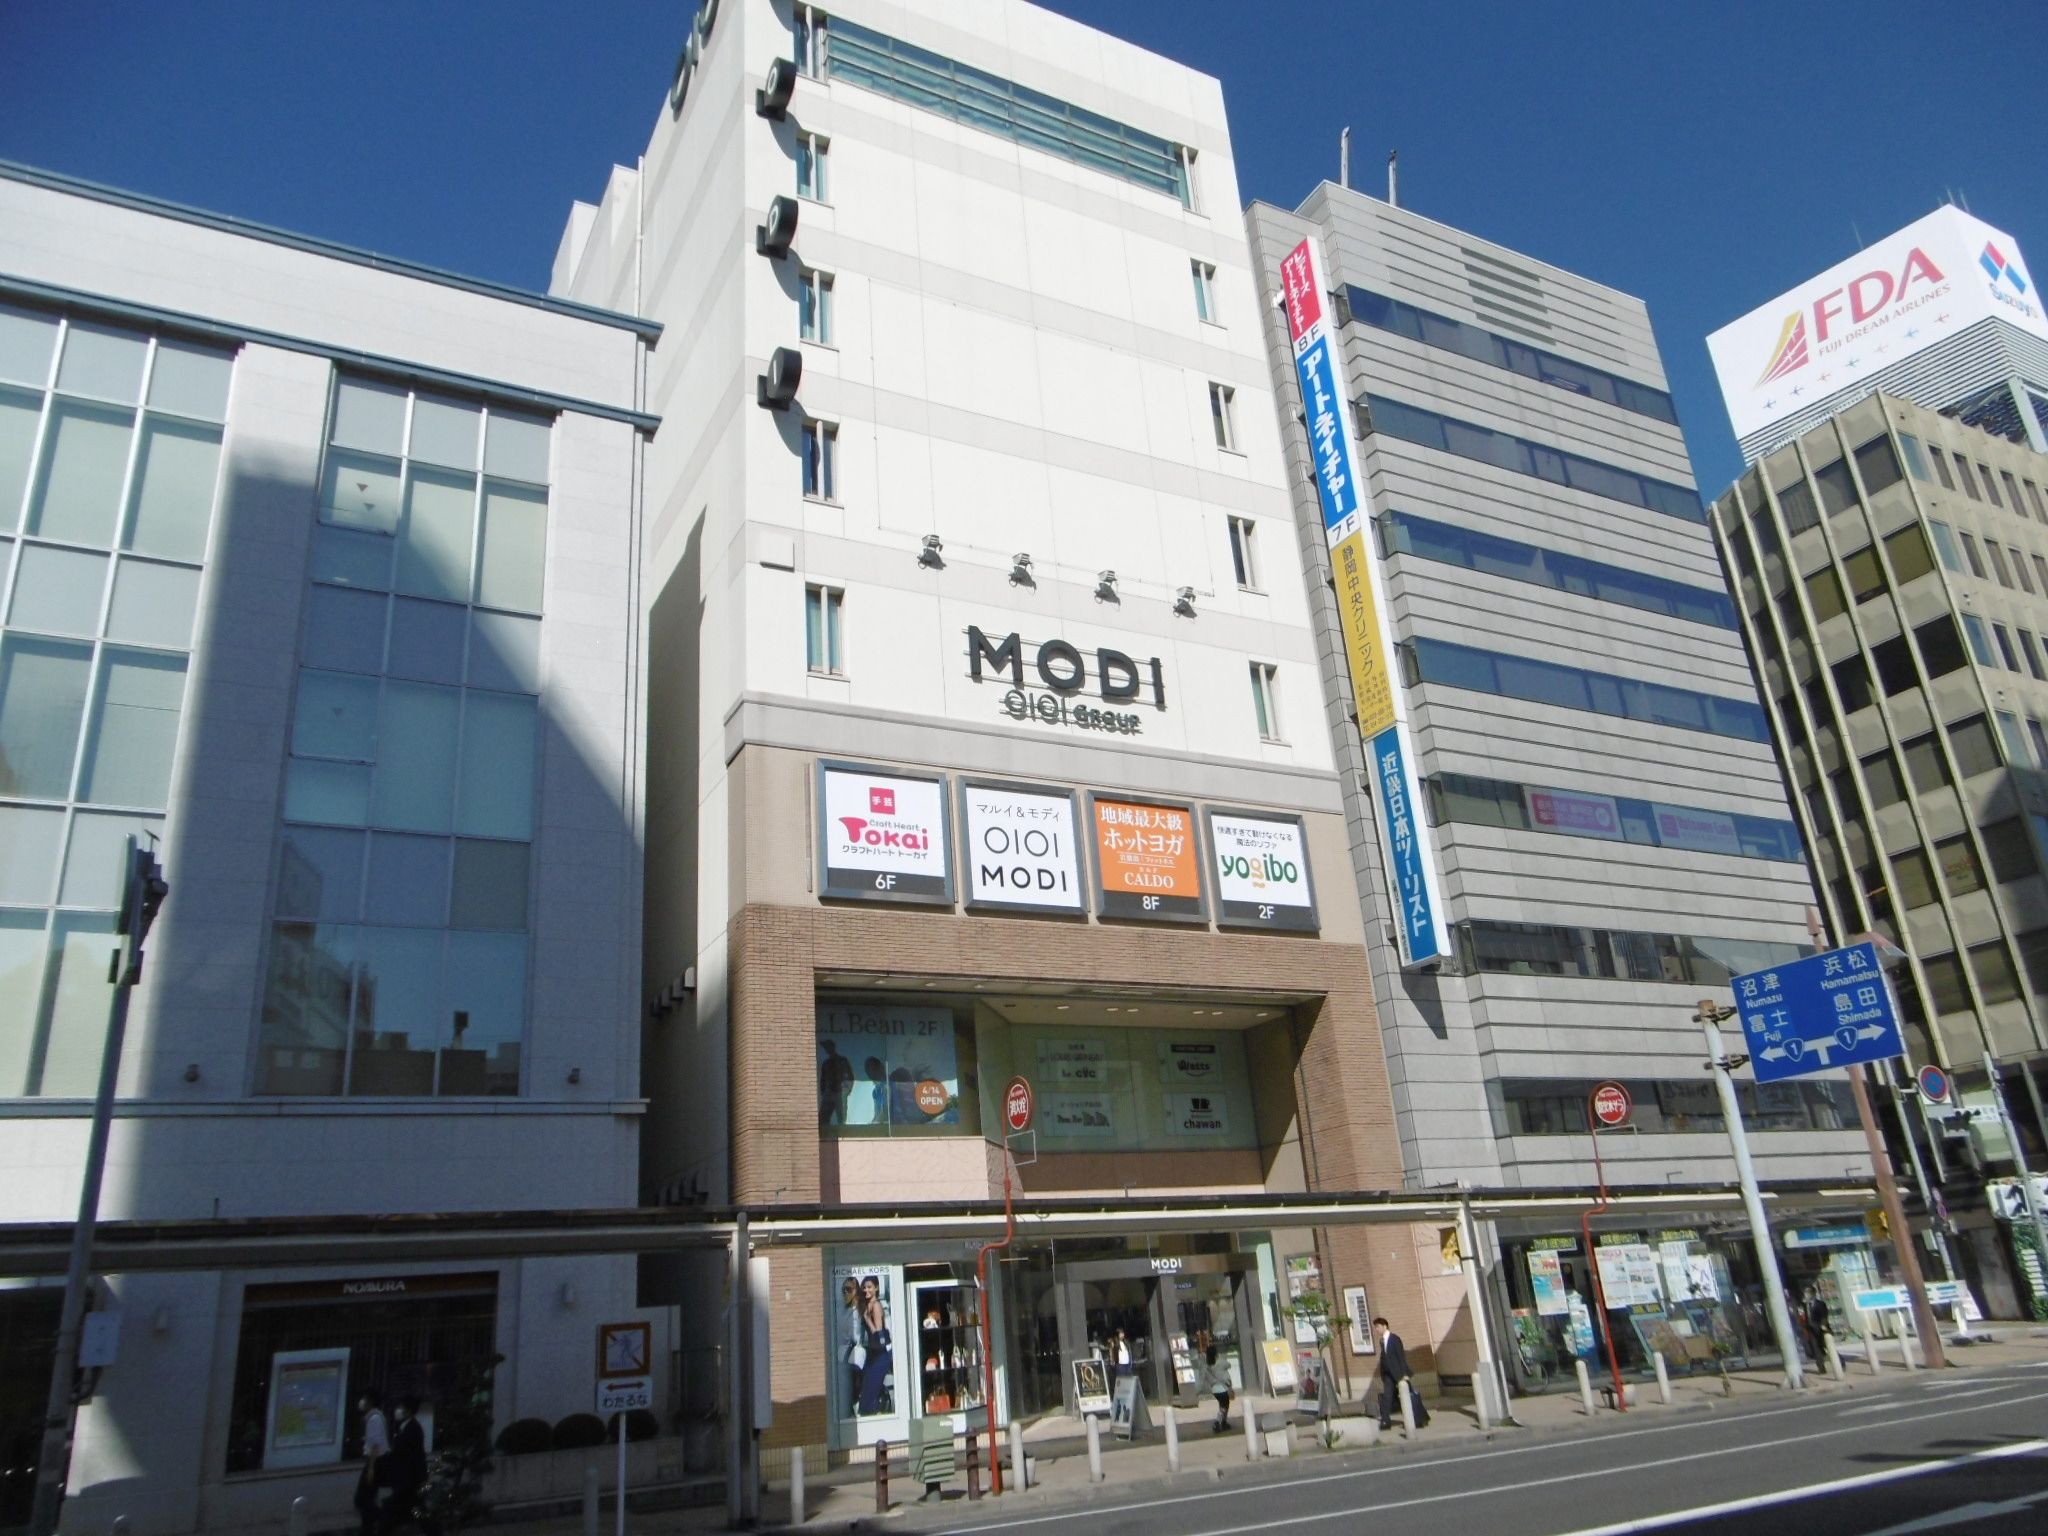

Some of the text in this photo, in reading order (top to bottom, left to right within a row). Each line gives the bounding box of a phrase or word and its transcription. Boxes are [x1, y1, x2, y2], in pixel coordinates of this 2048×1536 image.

[1294, 248, 1310, 298] レディース
[1284, 257, 1304, 333] アートネイチャー
[1813, 247, 1945, 343] FDA
[1818, 283, 1951, 357] FUJI DREAM AIRLINES
[1298, 324, 1319, 351] 8F
[1303, 347, 1345, 513] アートネイチャー
[1332, 515, 1355, 541] 7F
[1342, 545, 1373, 677] 静岡中央クリニック
[968, 625, 1165, 710] MODI
[869, 819, 920, 831] Craft Heart
[1101, 806, 1184, 831] 地域最大級
[838, 817, 928, 850] Tokai
[1103, 828, 1184, 856] ホットヨガ
[842, 845, 928, 859] クラフトハート トーカイ
[1382, 751, 1427, 937] 近畿日本ツーリスト
[981, 864, 1067, 892] MODI
[1220, 853, 1298, 884] yogibo
[875, 874, 896, 890] 6F
[1124, 872, 1174, 888] CALDO
[1142, 895, 1160, 910] 8F
[1258, 905, 1275, 919] 2F
[1823, 950, 1868, 976] 浜松
[1741, 973, 1781, 997] 沼津
[1821, 970, 1879, 990] Hamamatsu
[1746, 994, 1783, 1009] Numazu
[1833, 987, 1878, 1012] 島田
[1748, 1010, 1788, 1033] 富士
[1838, 1008, 1882, 1025] Shimada
[918, 1021, 938, 1036] 2F
[1763, 1031, 1782, 1043] Fuji
[1843, 1031, 1851, 1044] 1
[1790, 1042, 1798, 1055] 1
[922, 1086, 940, 1095] 4/14
[920, 1096, 943, 1106] OPEN
[1184, 1118, 1221, 1129] chawan
[833, 1266, 890, 1276] MICHAEL KORS
[1151, 1258, 1182, 1270] MODI
[343, 1280, 405, 1294] NOMURA
[602, 1394, 648, 1409] わたるな
